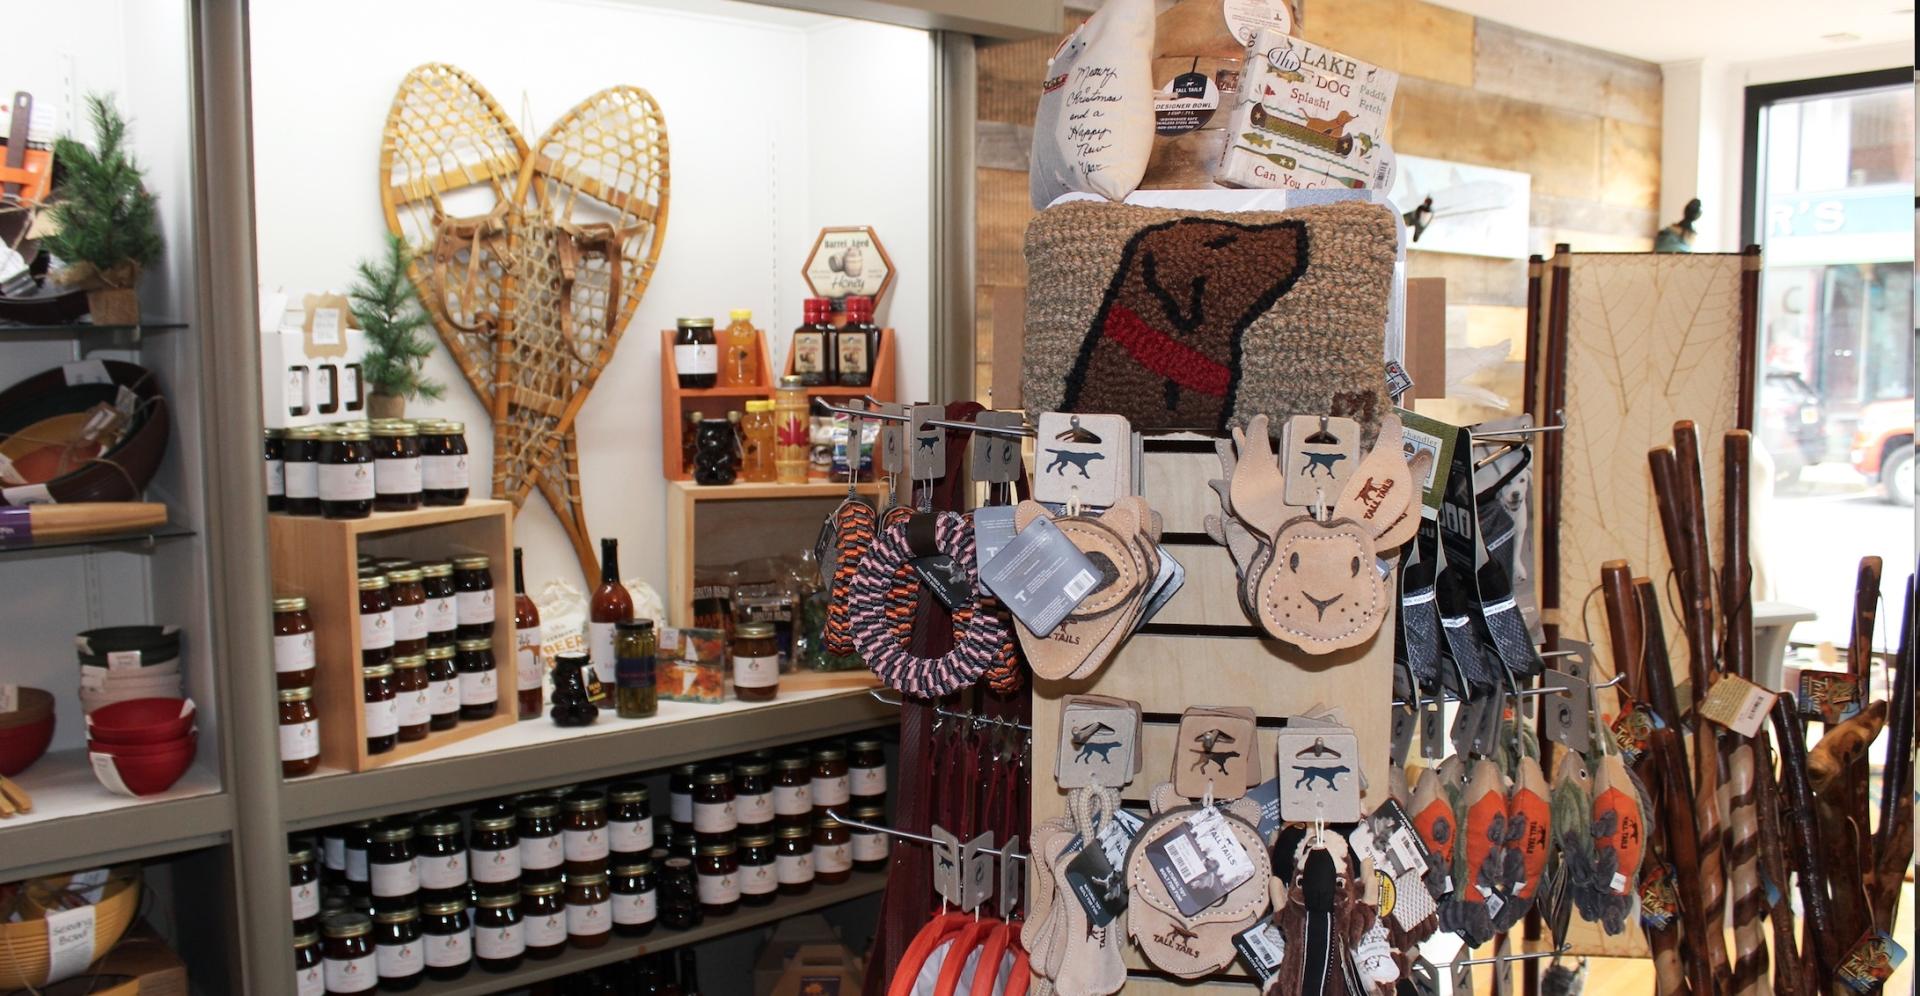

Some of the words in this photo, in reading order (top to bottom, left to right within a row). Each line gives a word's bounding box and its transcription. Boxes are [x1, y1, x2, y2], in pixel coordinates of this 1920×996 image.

[1302, 47, 1357, 80] LAKE
[1076, 66, 1117, 89] Merry
[1316, 76, 1350, 98] DOG
[1066, 87, 1123, 107] Christmas
[1290, 87, 1330, 110] Splash!
[1360, 84, 1387, 103] Paddle
[1069, 109, 1090, 120] and
[1359, 100, 1383, 114] Fetch
[1068, 125, 1112, 141] Happy
[1077, 143, 1112, 157] New
[1079, 161, 1110, 175] Year
[1254, 165, 1276, 181] Can
[825, 239, 847, 248] Barrel
[1363, 501, 1381, 520] TALL
[1376, 478, 1394, 499] TAILS
[543, 634, 583, 654] BEER
[1054, 633, 1080, 645] TAILS
[1115, 841, 1125, 856] TALL
[1210, 828, 1223, 849] TALL
[1222, 846, 1238, 867] TAILS
[1153, 934, 1174, 950] TALL
[1175, 944, 1200, 959] TAILS
